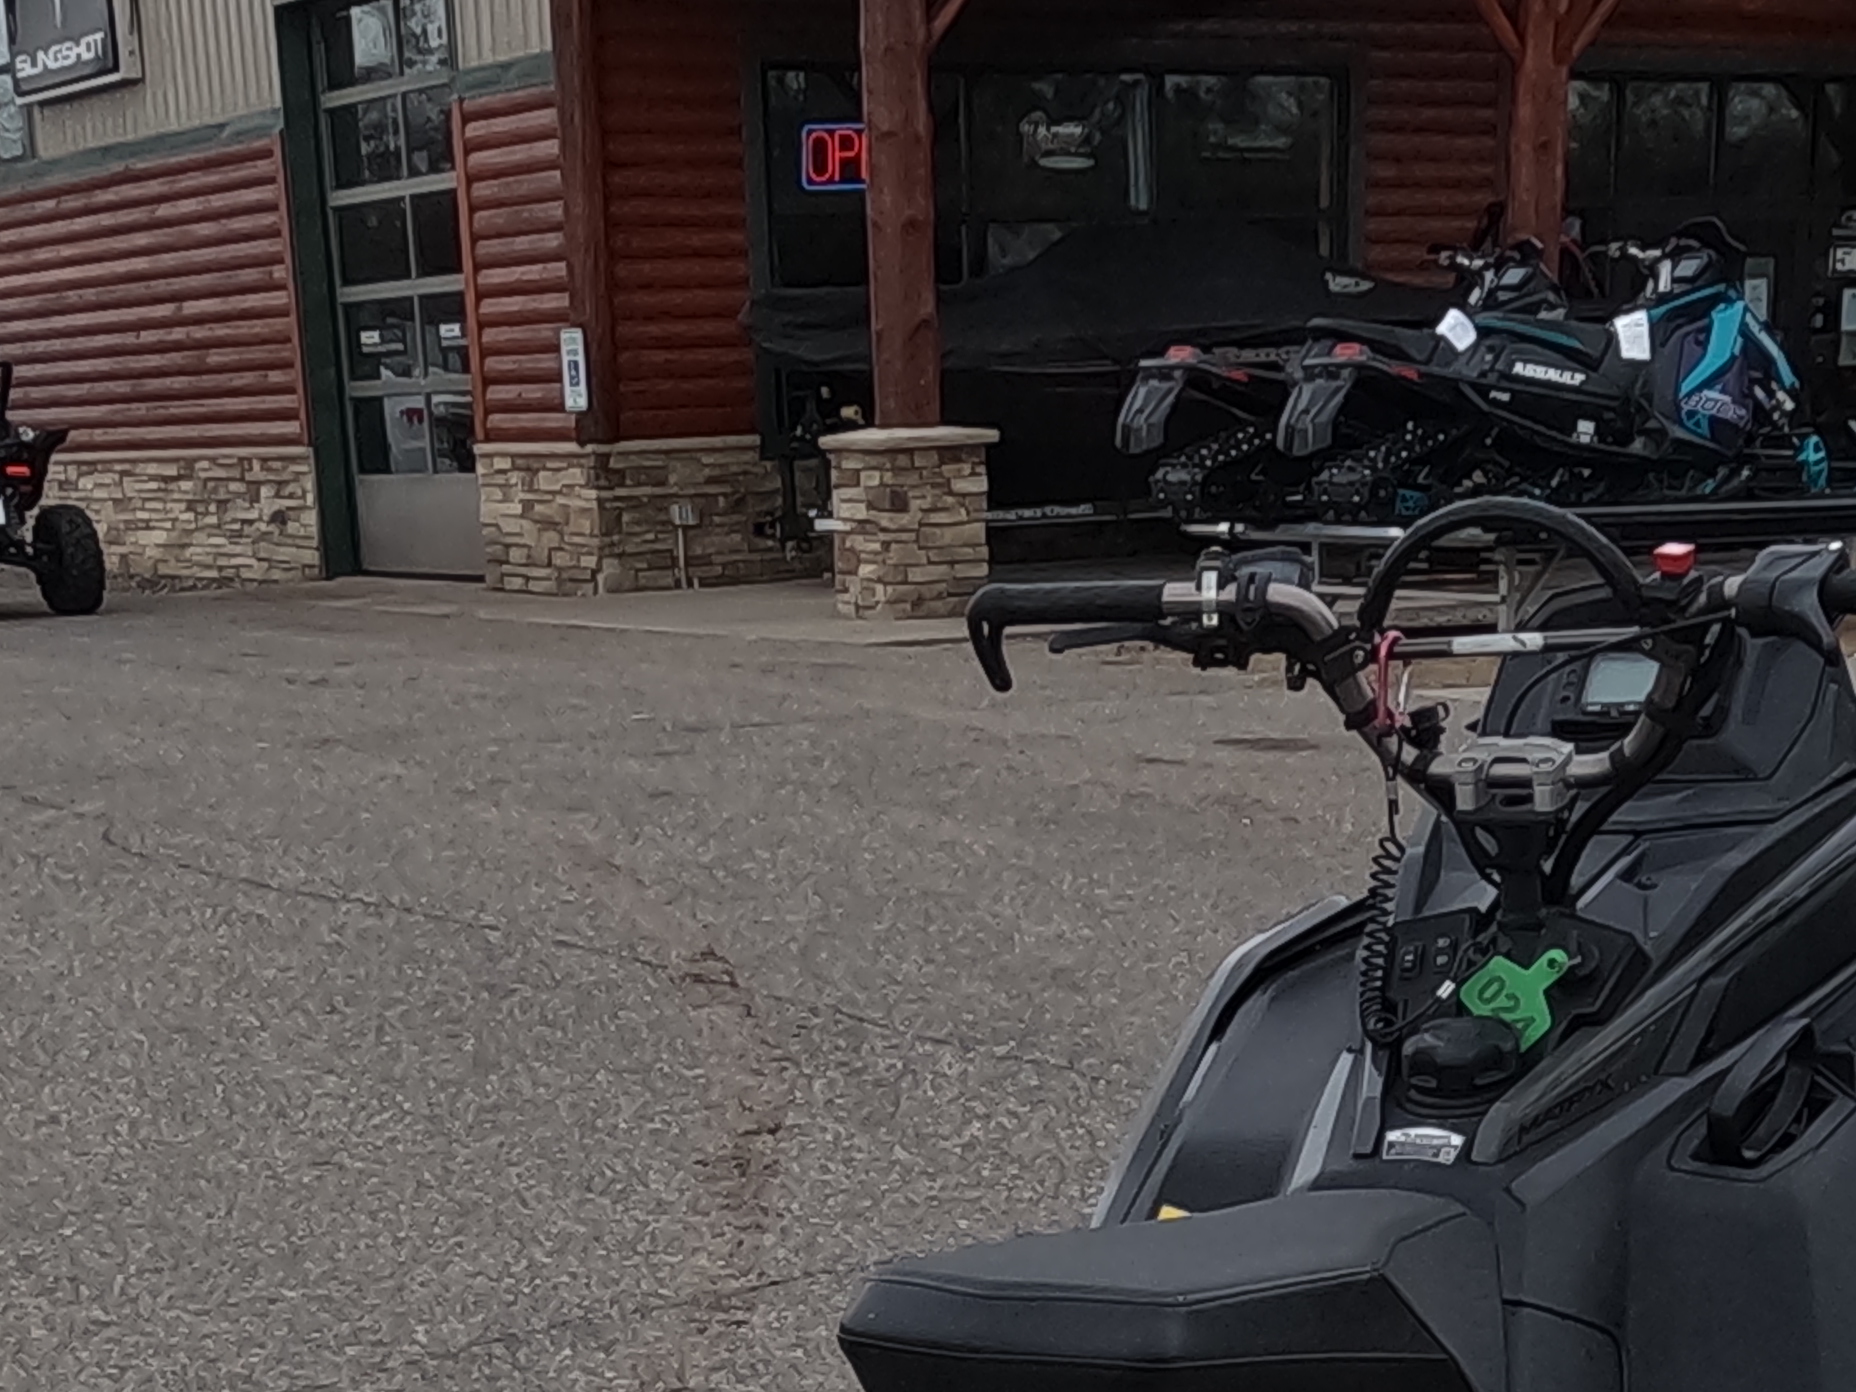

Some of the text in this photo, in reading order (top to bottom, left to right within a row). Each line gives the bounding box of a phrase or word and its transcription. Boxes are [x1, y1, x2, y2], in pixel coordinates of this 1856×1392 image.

[15, 31, 105, 79] SLINGSHOT
[808, 130, 869, 181] OP
[1511, 361, 1587, 386] ASSAULT
